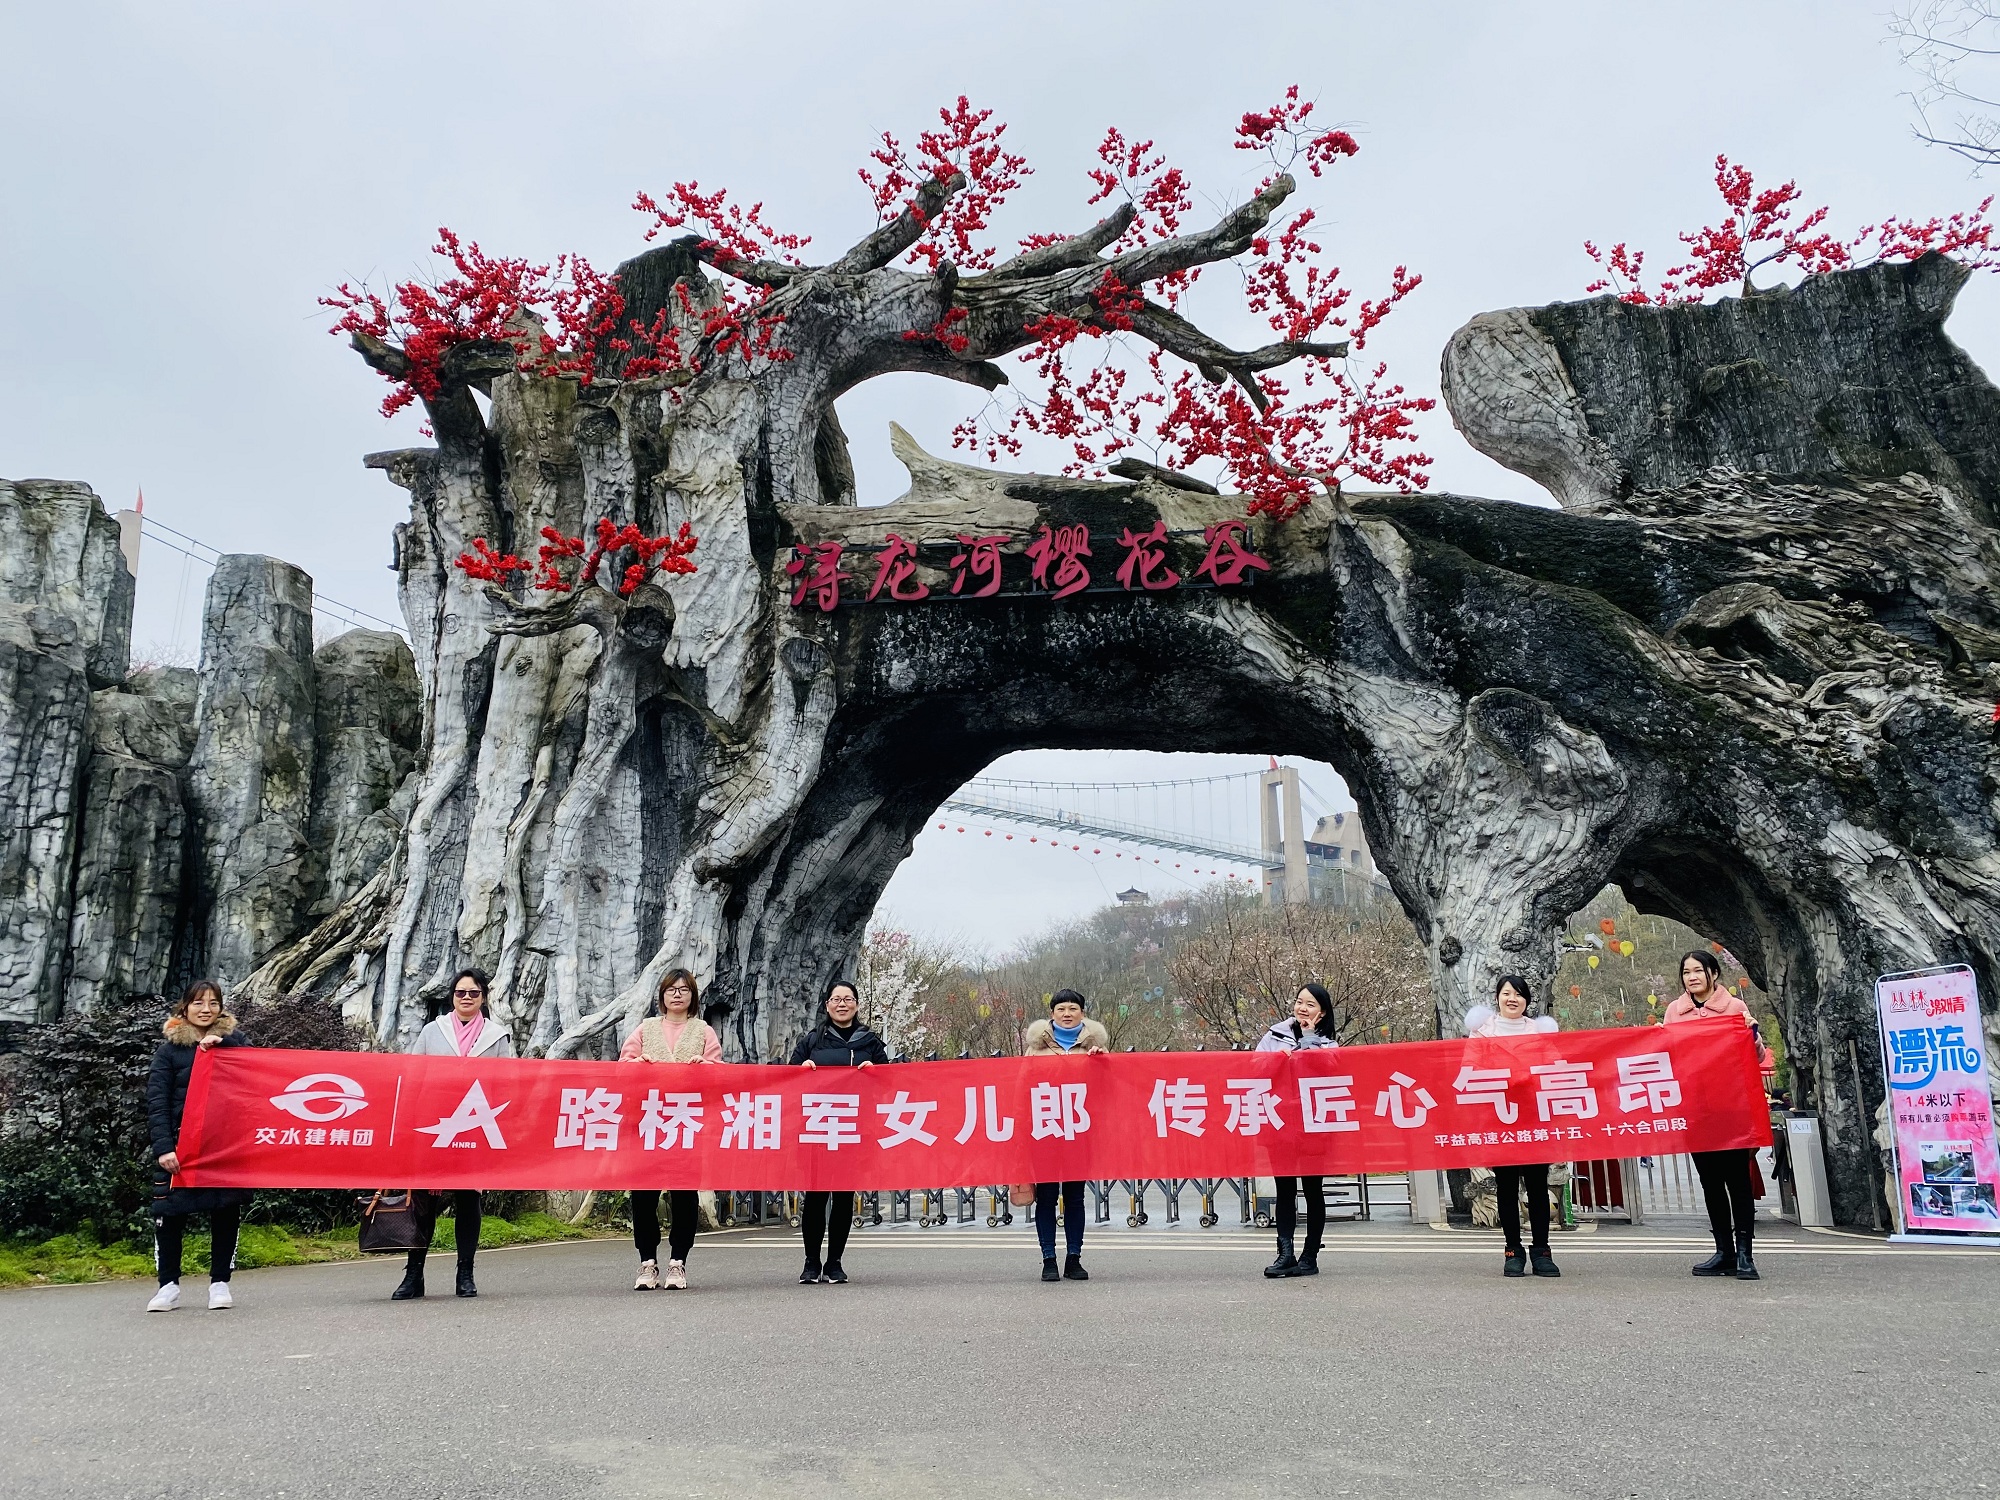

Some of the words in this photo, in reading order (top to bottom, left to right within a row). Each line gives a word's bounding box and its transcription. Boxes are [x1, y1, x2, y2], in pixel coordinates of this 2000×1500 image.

[786, 520, 1271, 612] 浔龙河樱花谷
[1889, 1025, 1981, 1090] 漂流
[554, 1082, 1091, 1151] 路桥湘军女儿郎
[1148, 1052, 1683, 1139] 传承匠心气高昂
[1906, 1093, 1966, 1108] 1.4米以下
[1899, 1112, 1987, 1124] 所有儿童必须购票游玩
[254, 1127, 374, 1146] 交水建集团
[451, 1141, 477, 1149] HNRB
[1434, 1117, 1689, 1148] 平益高速公路第十五、十六合同段
